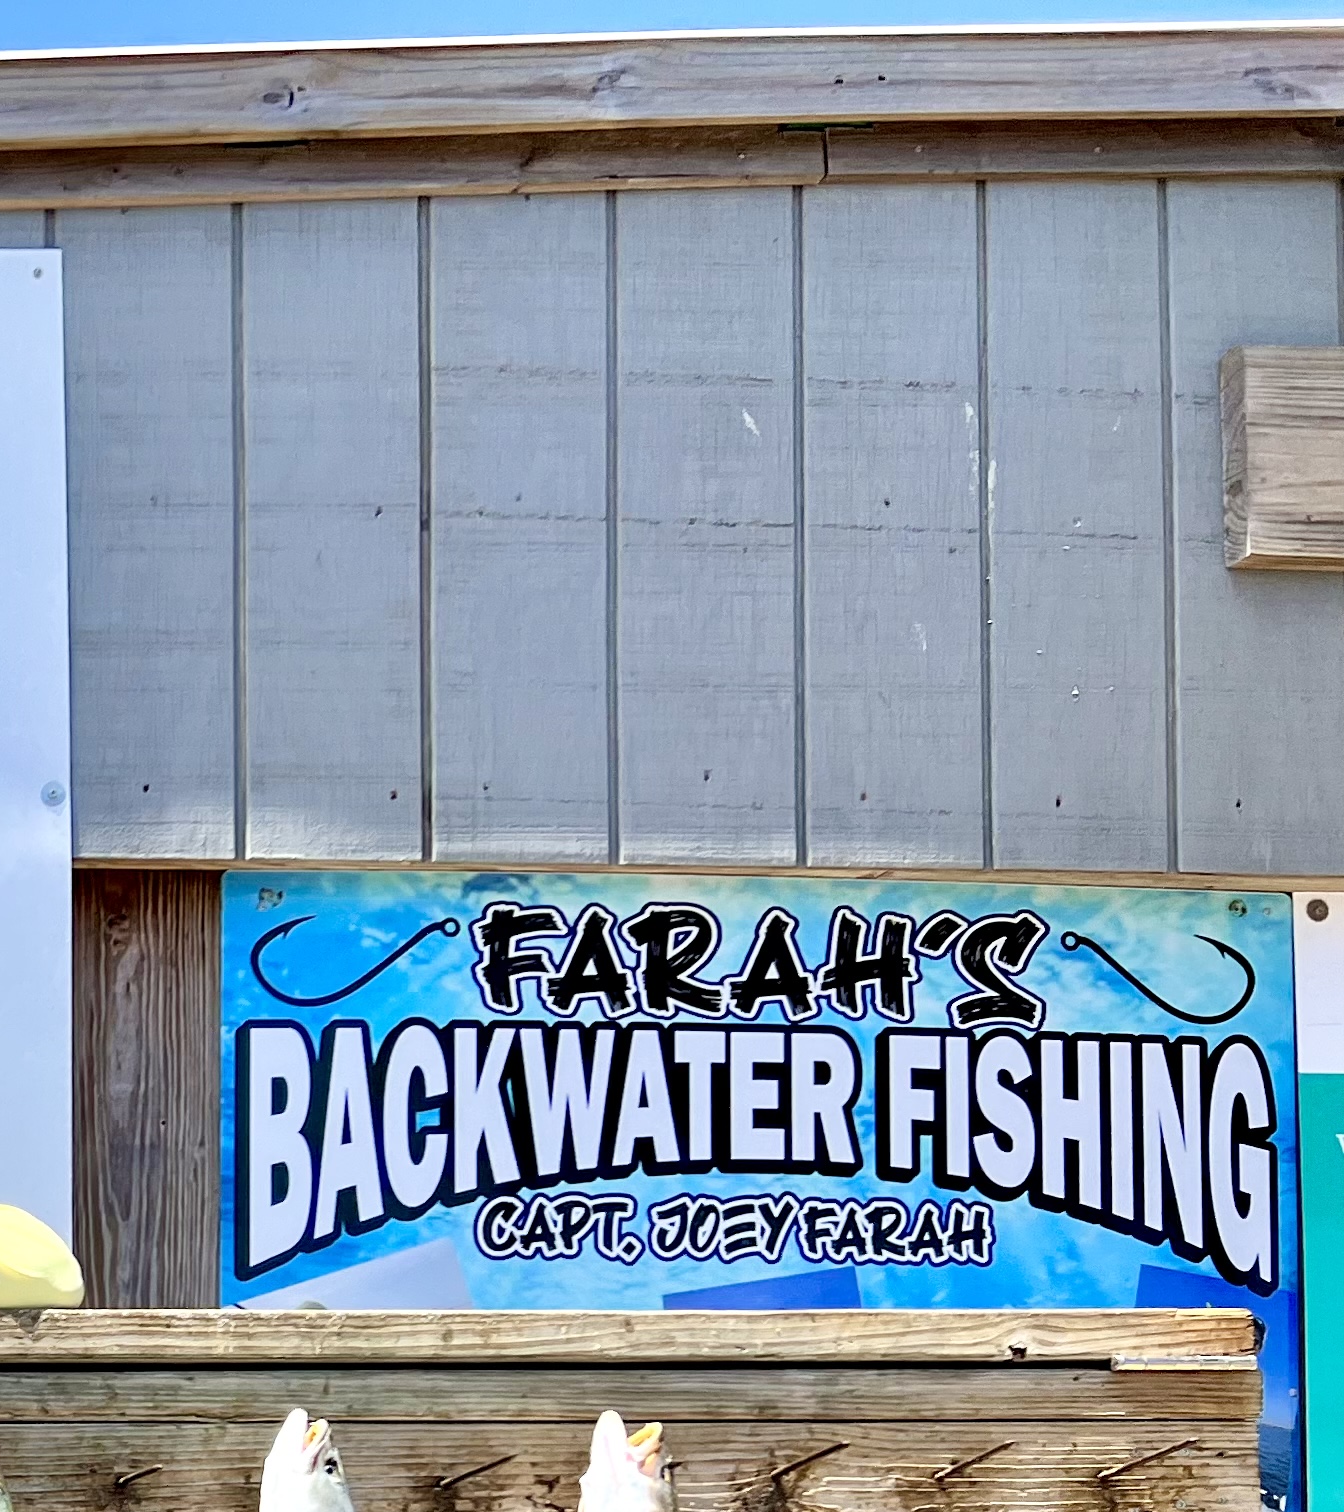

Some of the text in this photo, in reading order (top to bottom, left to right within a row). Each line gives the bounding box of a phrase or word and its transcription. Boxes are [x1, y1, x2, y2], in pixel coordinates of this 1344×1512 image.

[476, 906, 1046, 1027] FARAH'S
[244, 1023, 1277, 1287] BACKWATER FISHING
[481, 1197, 993, 1263] CAPT. JOEY FARAH
